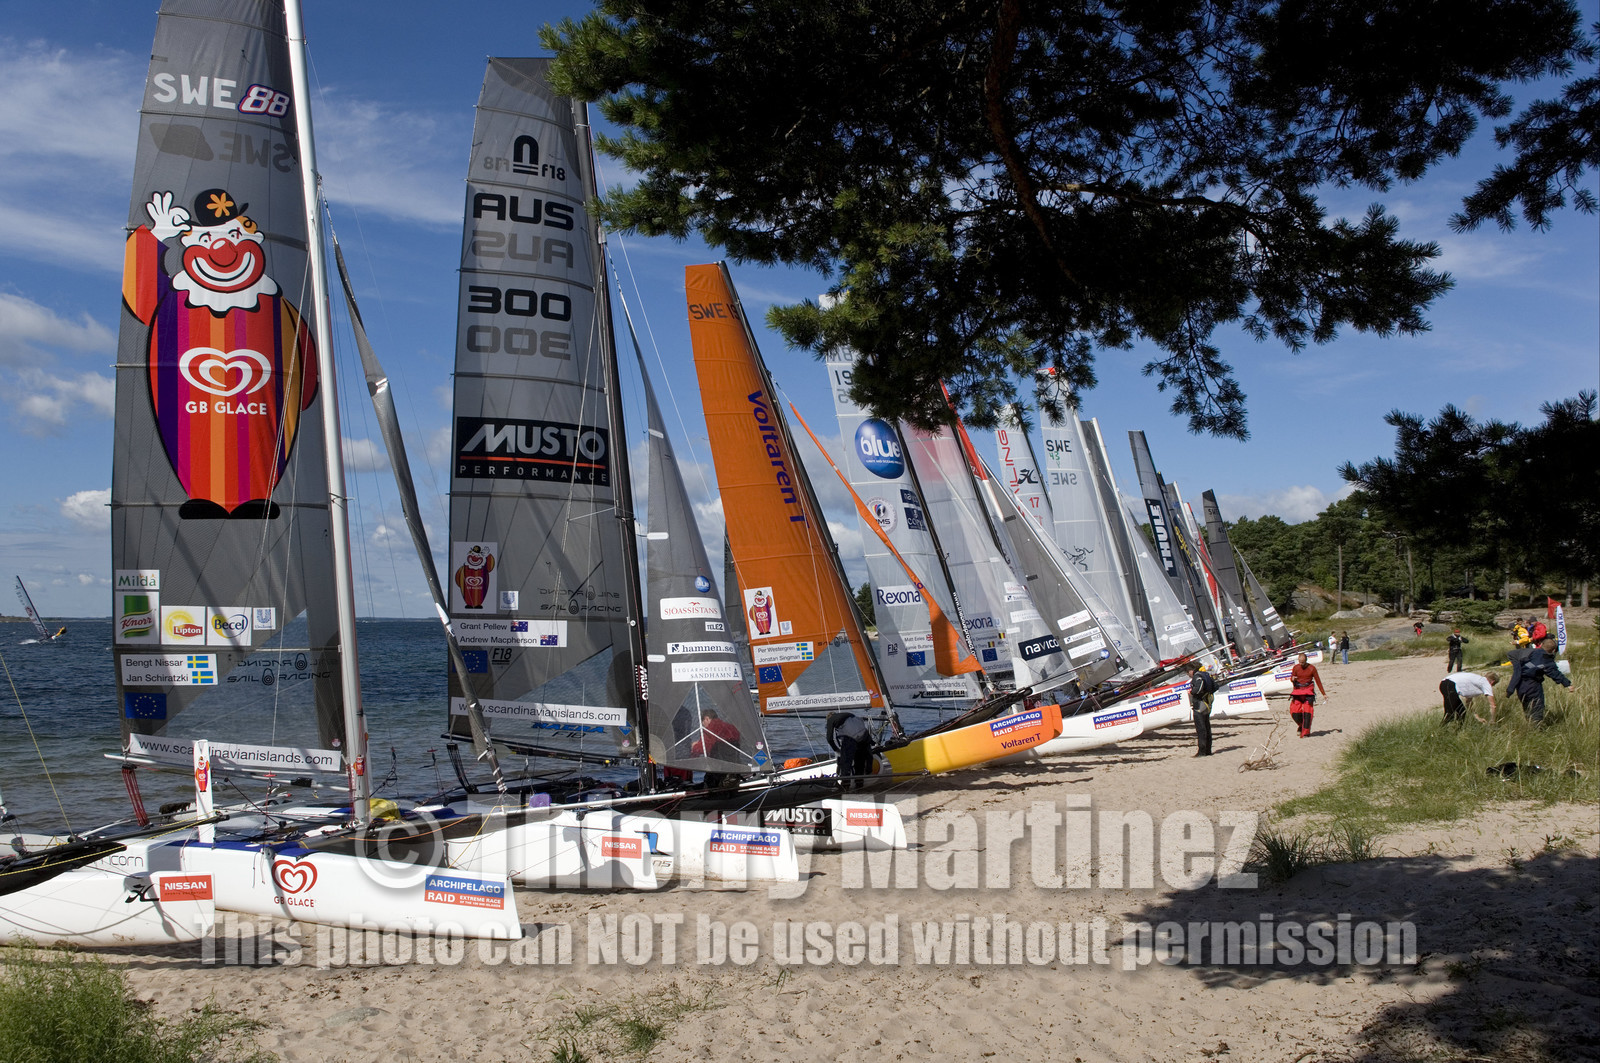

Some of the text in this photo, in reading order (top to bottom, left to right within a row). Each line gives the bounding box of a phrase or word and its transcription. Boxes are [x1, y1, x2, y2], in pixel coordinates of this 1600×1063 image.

[153, 73, 290, 117] SWE 88
[473, 193, 574, 231] AUS
[468, 285, 571, 322] 300
[689, 303, 728, 319] SWE
[185, 401, 267, 415] GB GLACE
[460, 423, 606, 460] MUSTO
[860, 434, 901, 458] blue
[1046, 440, 1072, 452] SWE
[747, 390, 810, 529] Voltaren T
[459, 465, 607, 482] PERFORMANCE
[1149, 504, 1174, 572] THULE
[118, 574, 157, 587] Milda
[876, 589, 921, 605] Rexona
[120, 616, 153, 629] Knorr
[214, 618, 246, 631] Becel
[460, 622, 507, 631] Grant Pellew
[964, 616, 993, 630] exona
[175, 626, 202, 636] Lipton
[490, 636, 537, 644] Macpherson
[682, 644, 734, 653] hamnen.se
[1025, 638, 1060, 656] navico
[491, 648, 512, 660] F18
[126, 658, 183, 668] Bengt Nissar
[126, 673, 189, 683] Jan Schiratzki
[227, 671, 332, 684] SAIL RACING
[639, 664, 649, 700] MUSTO
[1141, 695, 1178, 708] ARCHIPELAGO
[992, 712, 1041, 729] ARCHIPELAGO
[1095, 710, 1136, 722] ARCHIPELAGO
[1096, 721, 1112, 729] RAID
[993, 727, 1013, 737] RAID
[1001, 733, 1041, 749] Voltaren T
[765, 808, 825, 824] MUSTO
[713, 832, 778, 843] ARCHIPELAGO
[712, 843, 737, 852] RAID
[164, 881, 207, 891] NISSAN
[429, 878, 501, 894] ARCHIPELAGO
[273, 896, 315, 908] GB GLACE
[427, 891, 456, 903] RAID
[459, 895, 485, 903] EXTREME
